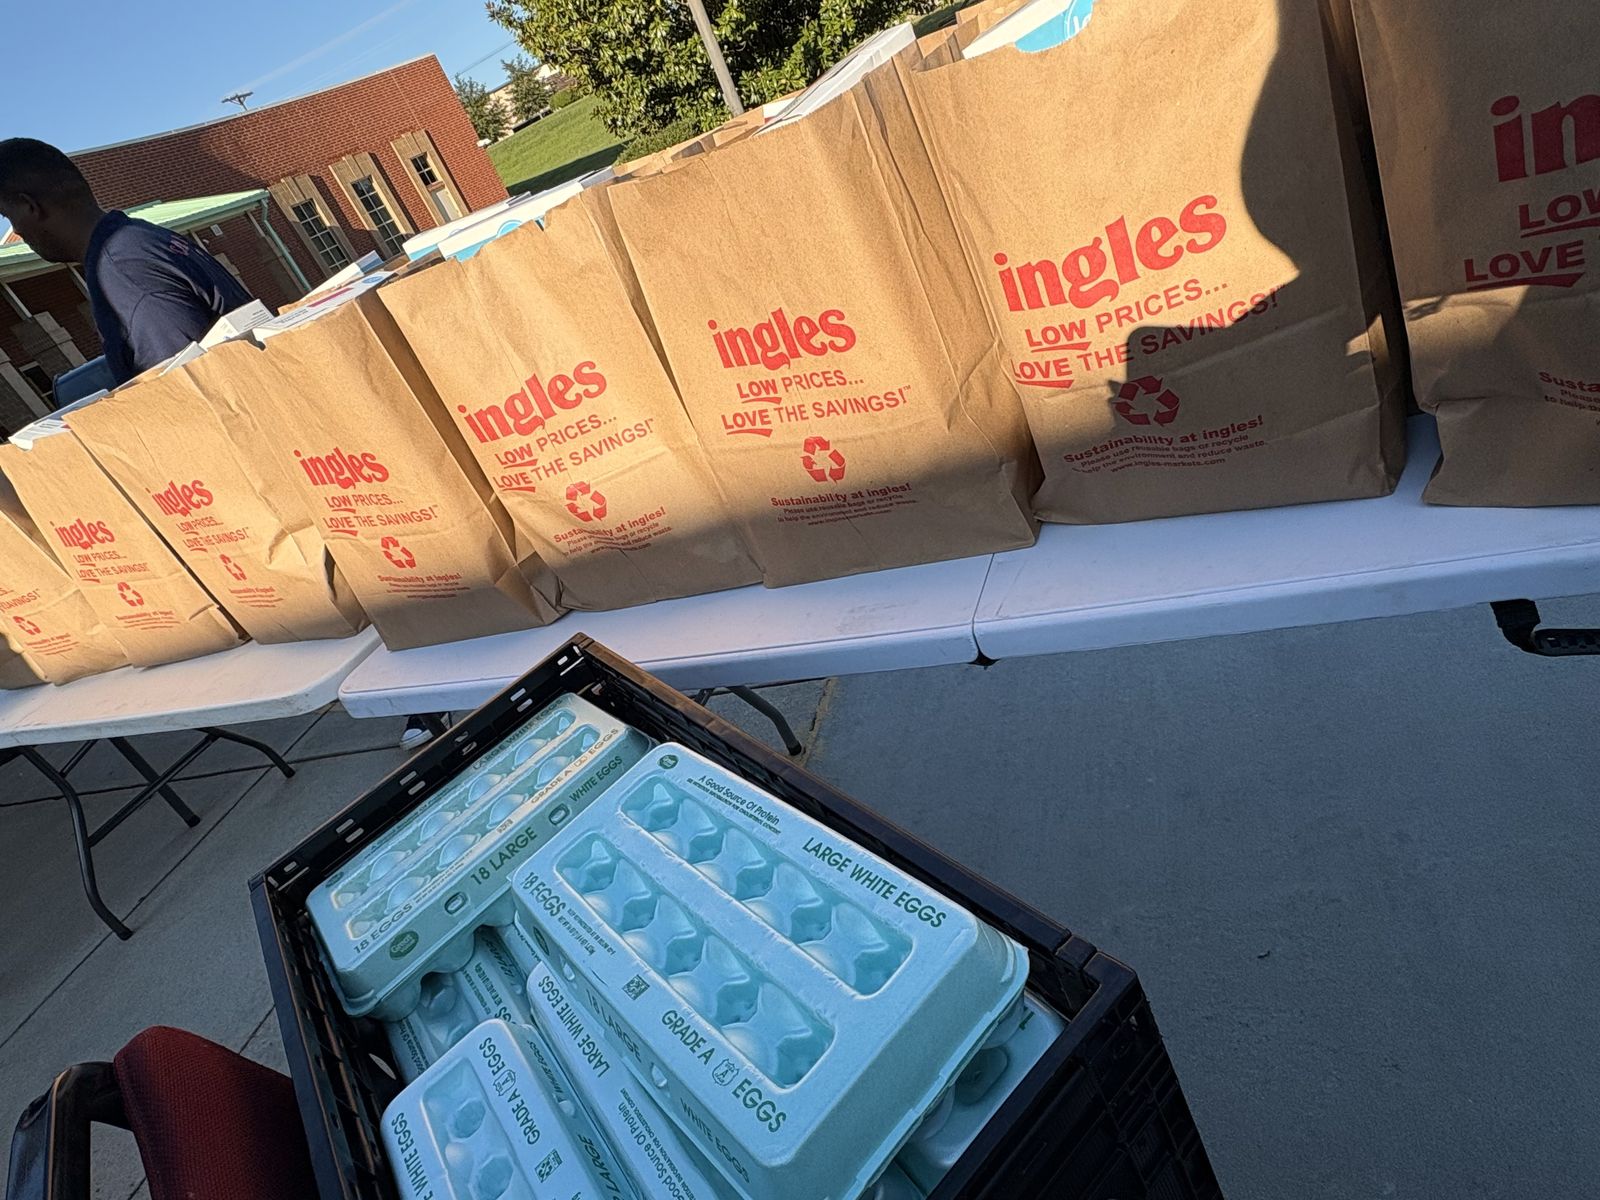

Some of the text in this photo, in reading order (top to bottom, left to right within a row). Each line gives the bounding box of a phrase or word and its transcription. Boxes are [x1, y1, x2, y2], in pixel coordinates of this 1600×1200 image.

[994, 195, 1227, 311] ingles
[1463, 239, 1585, 282] LOVE
[1025, 278, 1228, 347] LOW PRICES...
[708, 307, 856, 371] ingles
[1077, 342, 1133, 371] THE
[457, 361, 608, 443] ingles
[736, 370, 864, 398] LOW PRICES...
[721, 409, 772, 430] LOVE
[774, 404, 809, 424] THE
[1063, 414, 1264, 463] Sustainability at ingles!
[494, 414, 617, 466] LOW PRICES...
[293, 446, 390, 489] ingles
[493, 472, 532, 489] LOVE
[531, 457, 568, 482] THE
[145, 480, 214, 517] ingles
[323, 493, 403, 509] LOW PRICES...
[770, 482, 912, 507] Sustainability at ingles!
[50, 518, 115, 550] ingles
[323, 516, 356, 529] LOVE
[355, 514, 378, 528] THE
[615, 523, 627, 533] at
[628, 506, 666, 528] ingles!
[73, 552, 92, 563] LOW
[76, 568, 97, 578] LOVE
[530, 728, 619, 804] GRADE A EGGS
[470, 865, 490, 886] 18
[489, 827, 538, 871] LARGE
[569, 775, 598, 802] WHITE
[596, 755, 623, 782] EGGS
[705, 778, 725, 793] Good
[723, 788, 747, 806] Source
[745, 801, 757, 811] Of
[754, 806, 780, 826] Protein
[521, 871, 566, 917] 18 EGGS
[802, 837, 946, 928] LARGE WHITE EGGS
[353, 938, 370, 954] 18
[371, 903, 412, 940] EGGS
[538, 975, 610, 1078] LARGE WHITE EGGS
[600, 1005, 641, 1063] LARGE
[479, 1037, 506, 1077] EGGS
[661, 1009, 787, 1133] GRADE A EGGS
[507, 1087, 521, 1103] A
[391, 1112, 415, 1151] EGGS
[511, 1102, 542, 1145] GRADE
[618, 1102, 640, 1136] Protein
[633, 1130, 647, 1146] Of
[680, 1097, 714, 1143] WHITE
[403, 1146, 429, 1197] WHITE
[577, 1133, 620, 1193] LARGE
[643, 1142, 667, 1179] Source
